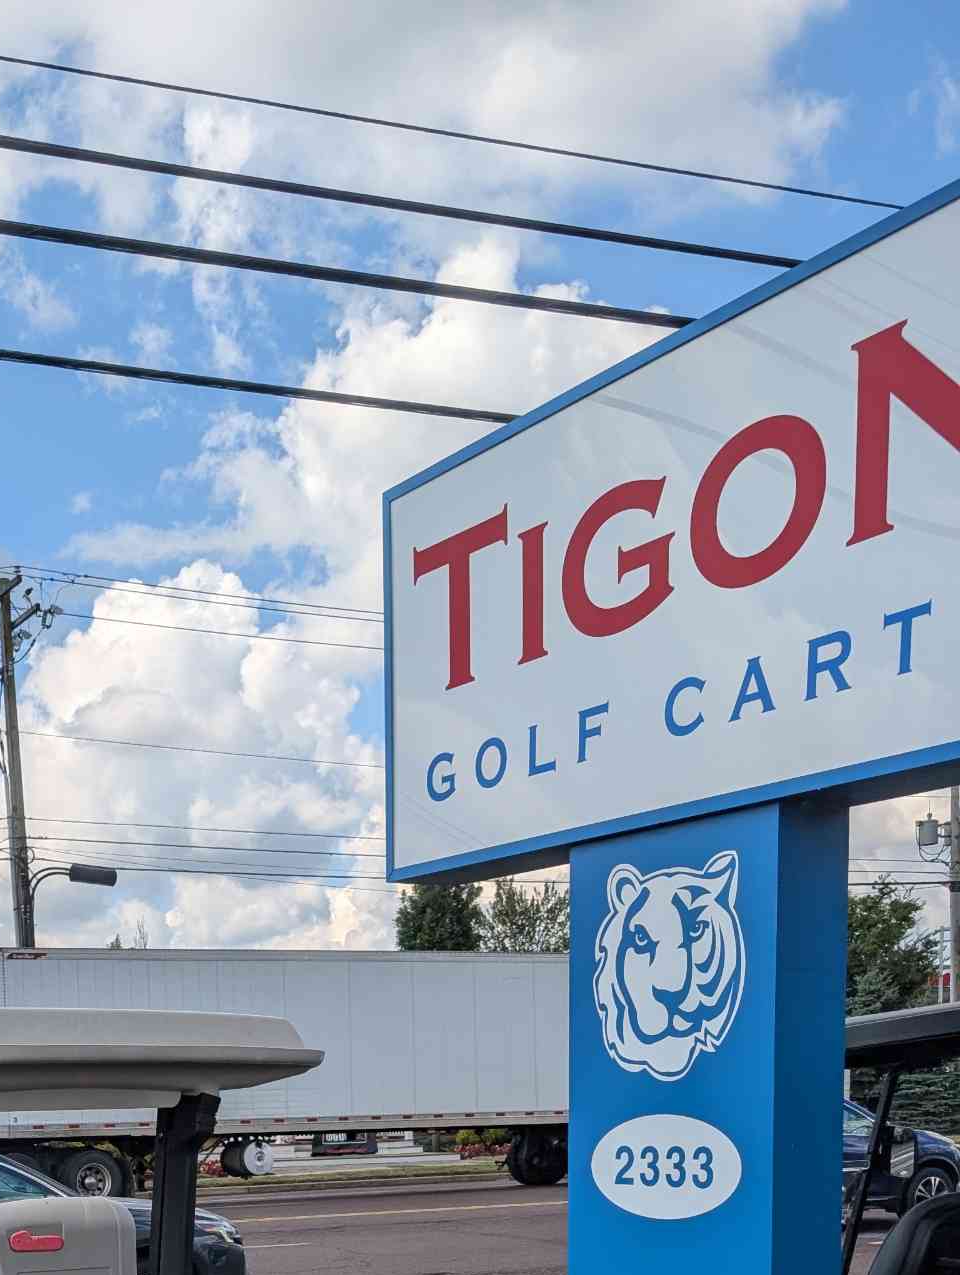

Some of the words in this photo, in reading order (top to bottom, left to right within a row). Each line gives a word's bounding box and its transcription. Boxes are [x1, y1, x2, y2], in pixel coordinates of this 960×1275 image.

[426, 701, 610, 802] GOLF
[664, 599, 932, 737] CART
[614, 1145, 714, 1189] 2333
